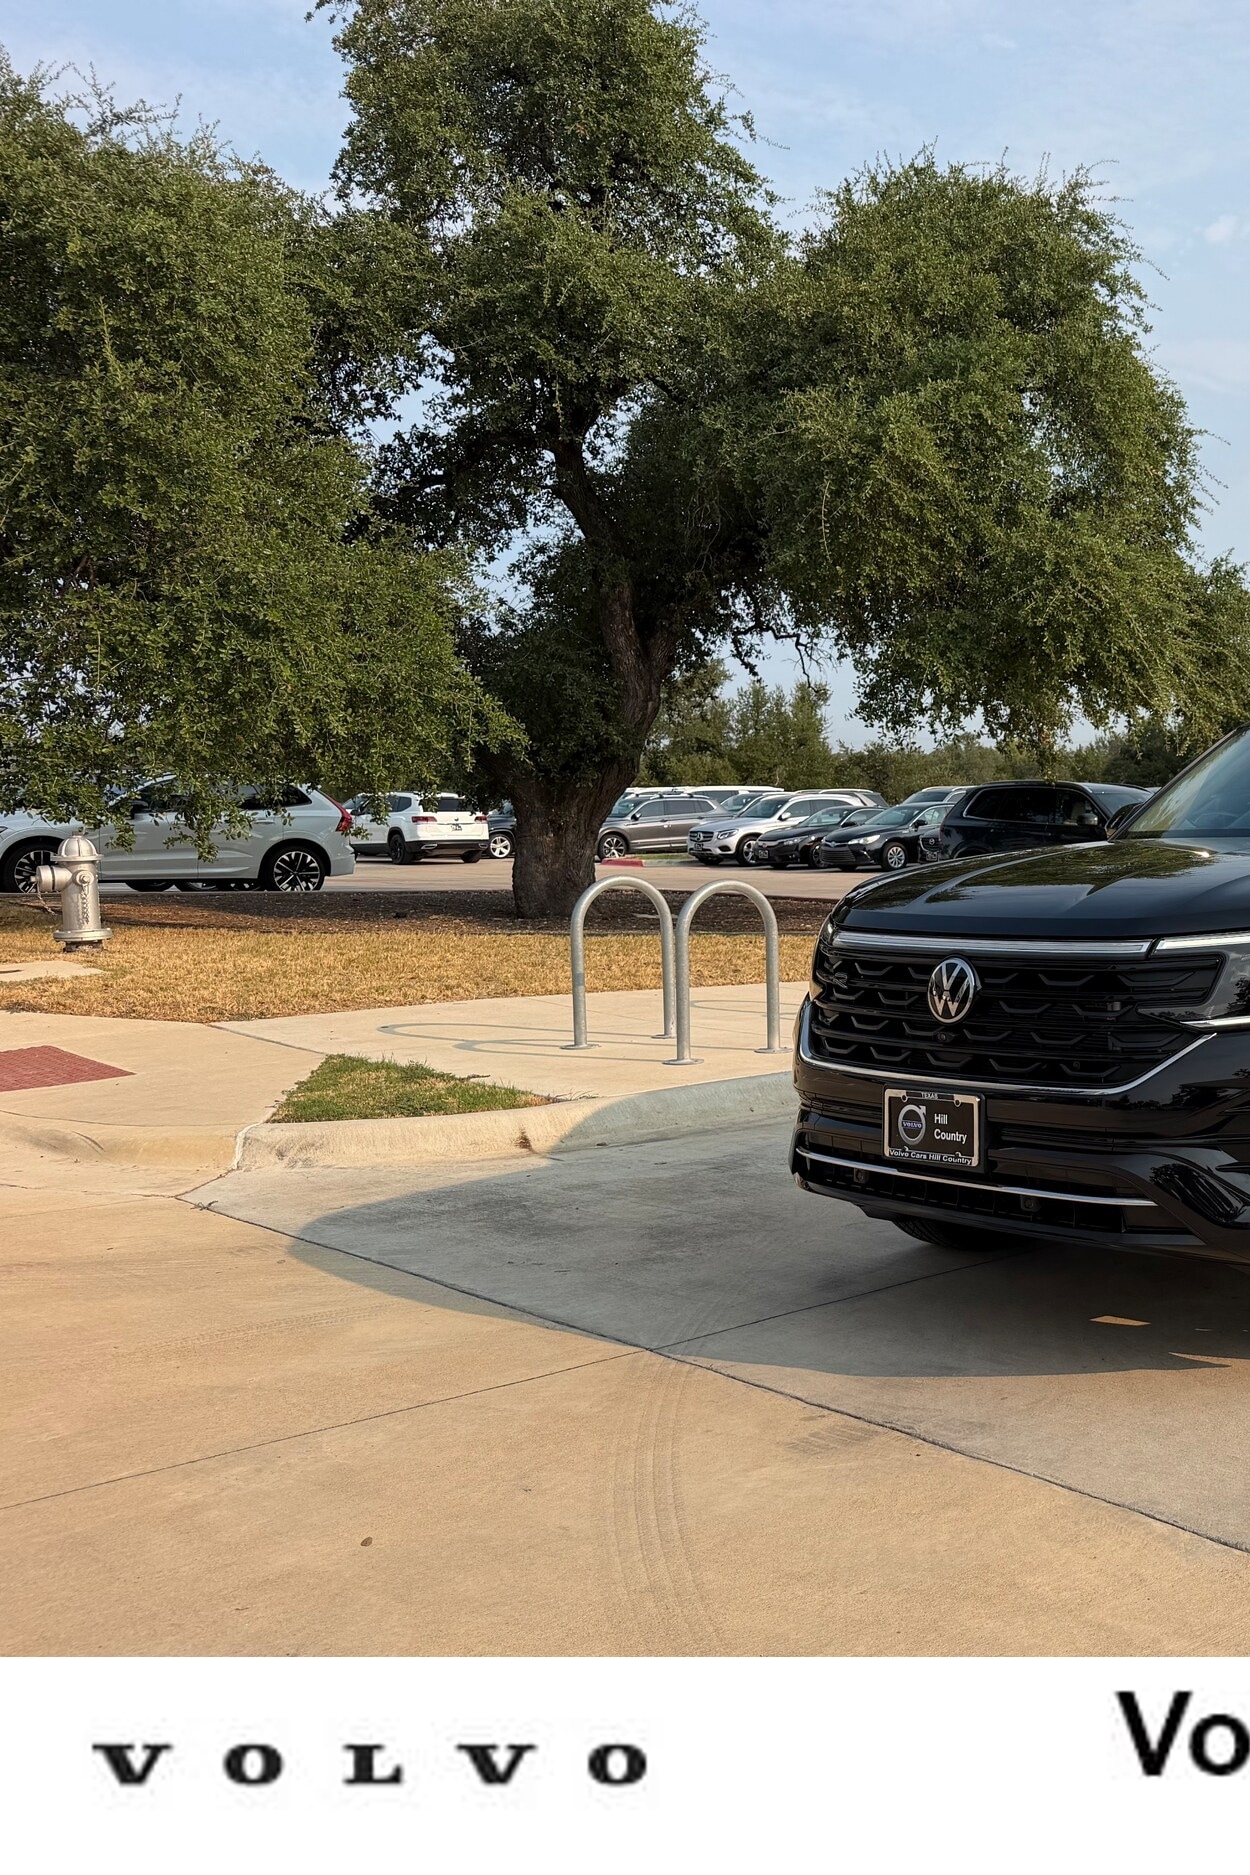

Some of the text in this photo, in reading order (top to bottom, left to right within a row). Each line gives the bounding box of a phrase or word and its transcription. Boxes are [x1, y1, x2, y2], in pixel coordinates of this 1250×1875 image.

[921, 1092, 938, 1100] TEXAS
[902, 1121, 922, 1129] VOLVO
[934, 1113, 948, 1125] Hill
[933, 1128, 967, 1144] Country
[889, 1149, 972, 1165] Volvo Cars Hill Country
